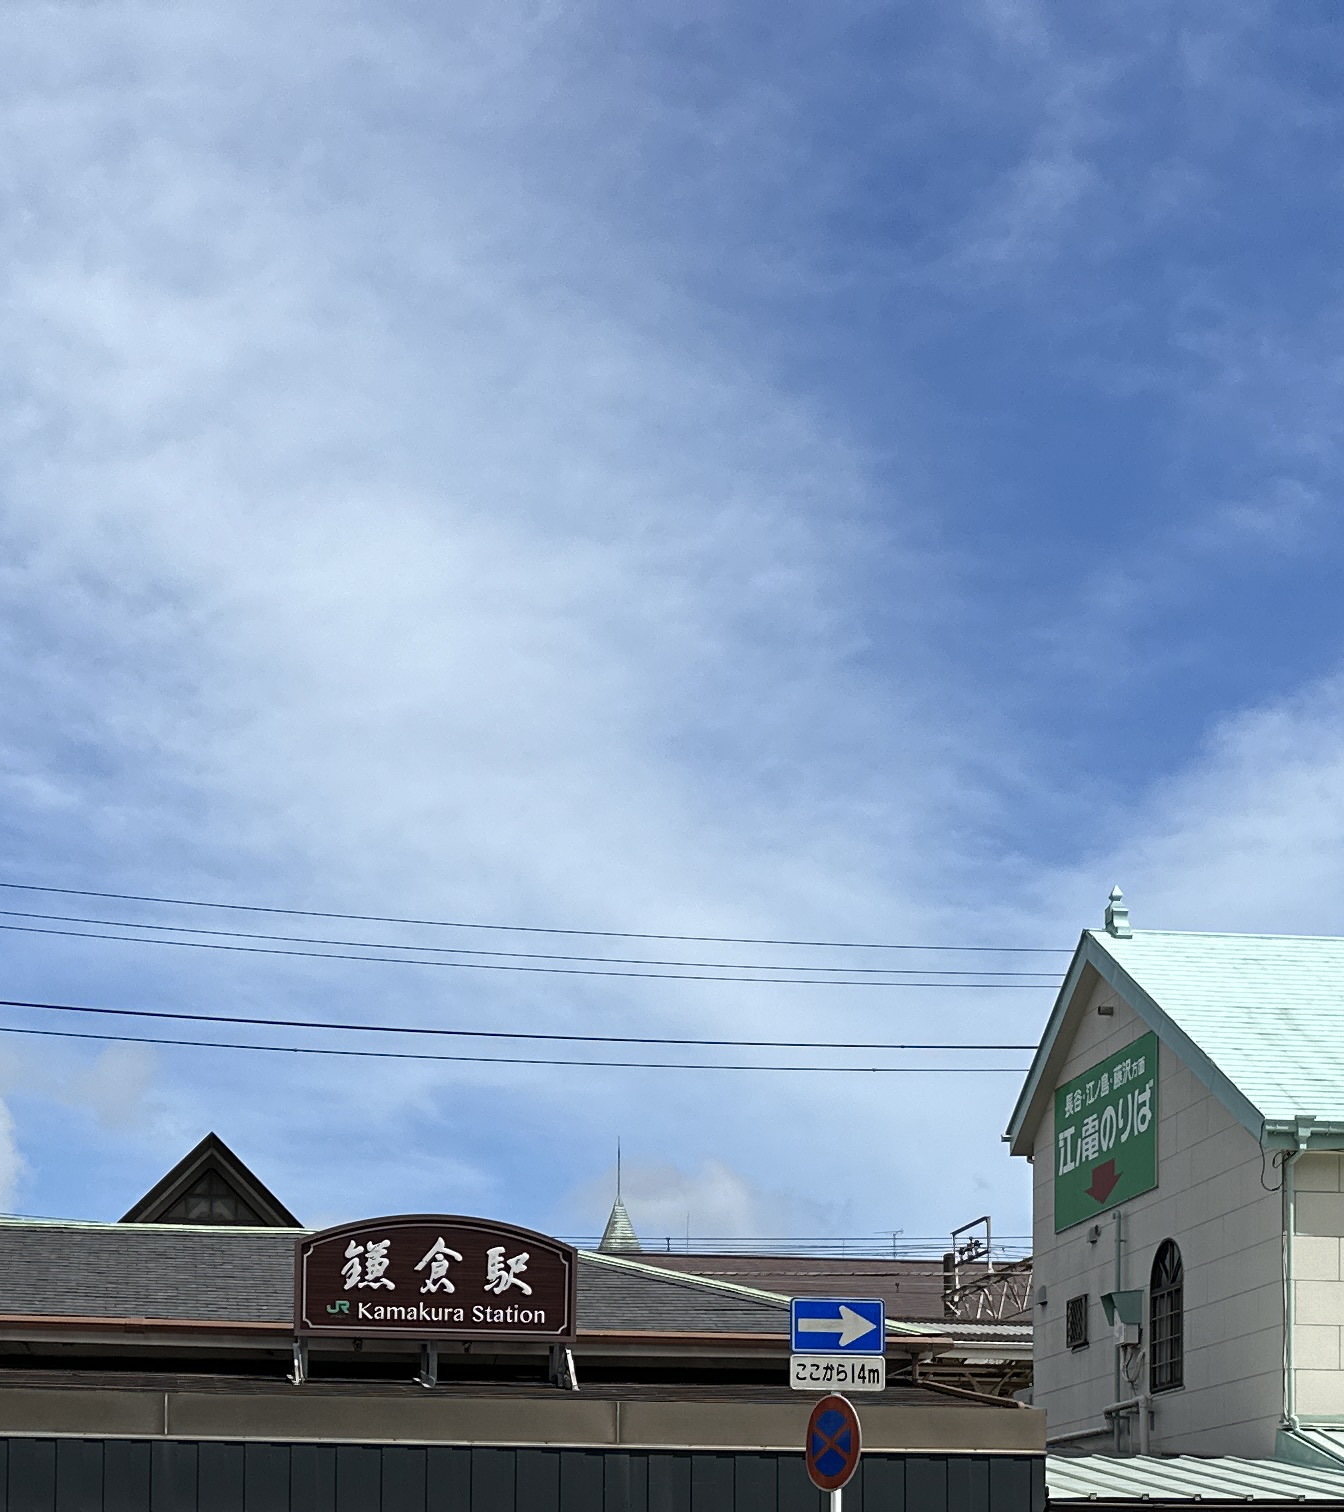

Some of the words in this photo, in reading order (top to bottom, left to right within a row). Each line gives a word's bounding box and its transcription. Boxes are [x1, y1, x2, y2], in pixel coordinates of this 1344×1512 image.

[1064, 1056, 1145, 1118] 長谷・江ノ島・藤沢方面
[1058, 1079, 1154, 1176] 江ノ電のりば
[340, 1236, 533, 1296] 鎌倉駅
[326, 1300, 350, 1314] JR
[358, 1302, 464, 1321] Kamakura
[472, 1304, 546, 1324] Station
[796, 1363, 879, 1384] ここから14m
